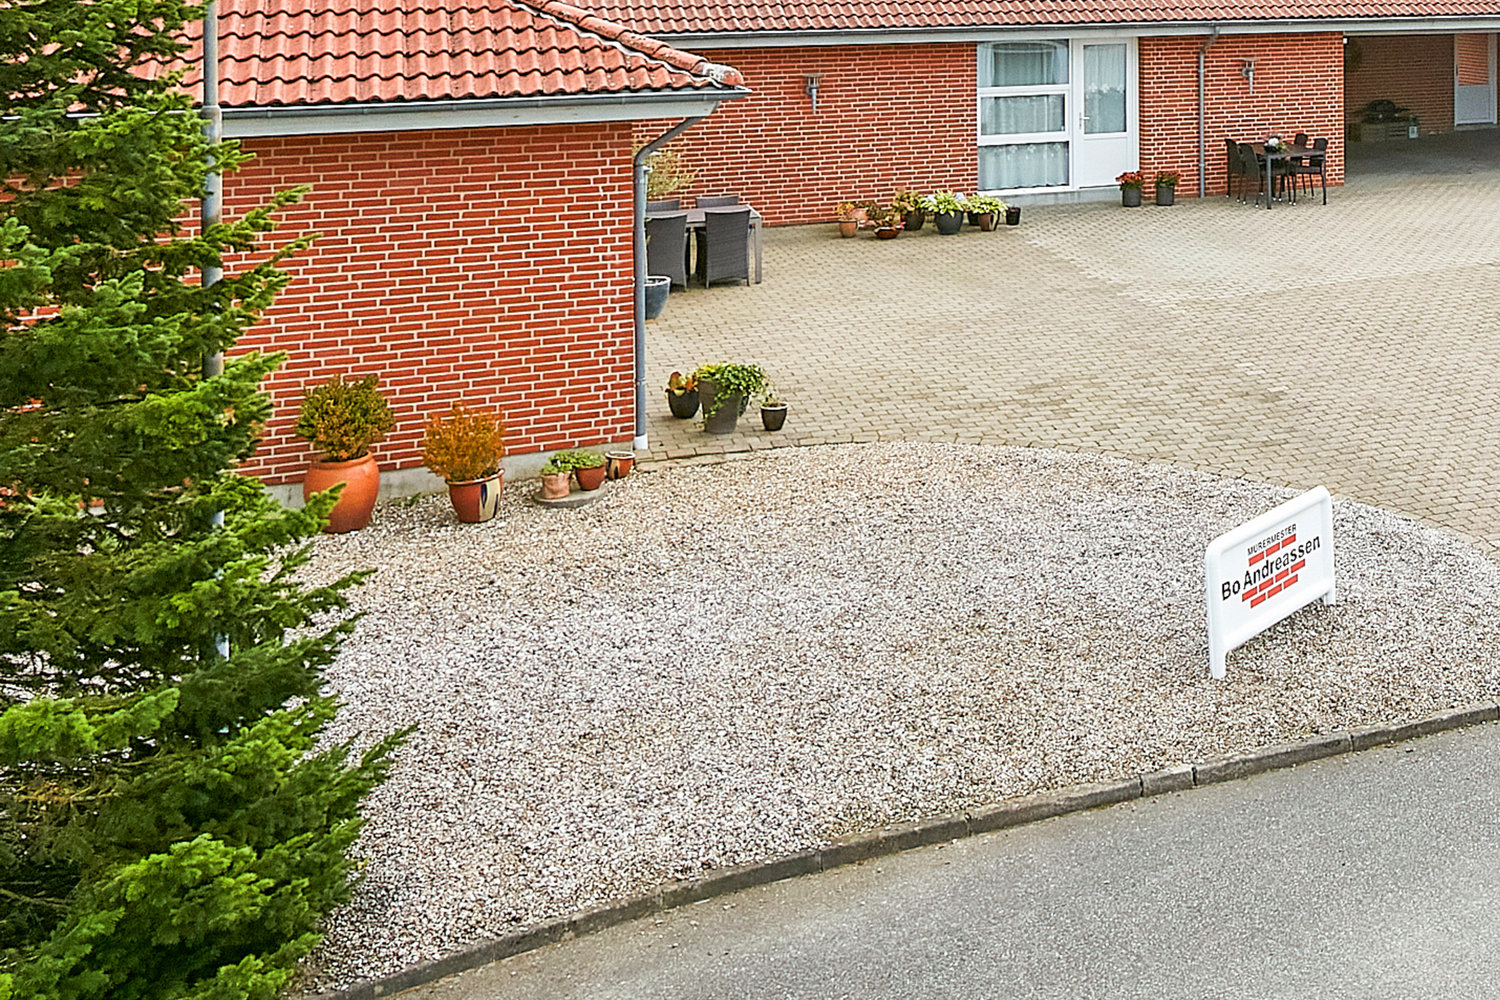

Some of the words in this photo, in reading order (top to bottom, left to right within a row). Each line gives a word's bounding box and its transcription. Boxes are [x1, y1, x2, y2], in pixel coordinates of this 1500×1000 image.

[1247, 523, 1297, 555] MURERMESTER
[1222, 580, 1241, 601] Bo
[1243, 535, 1320, 590] Andreassen
